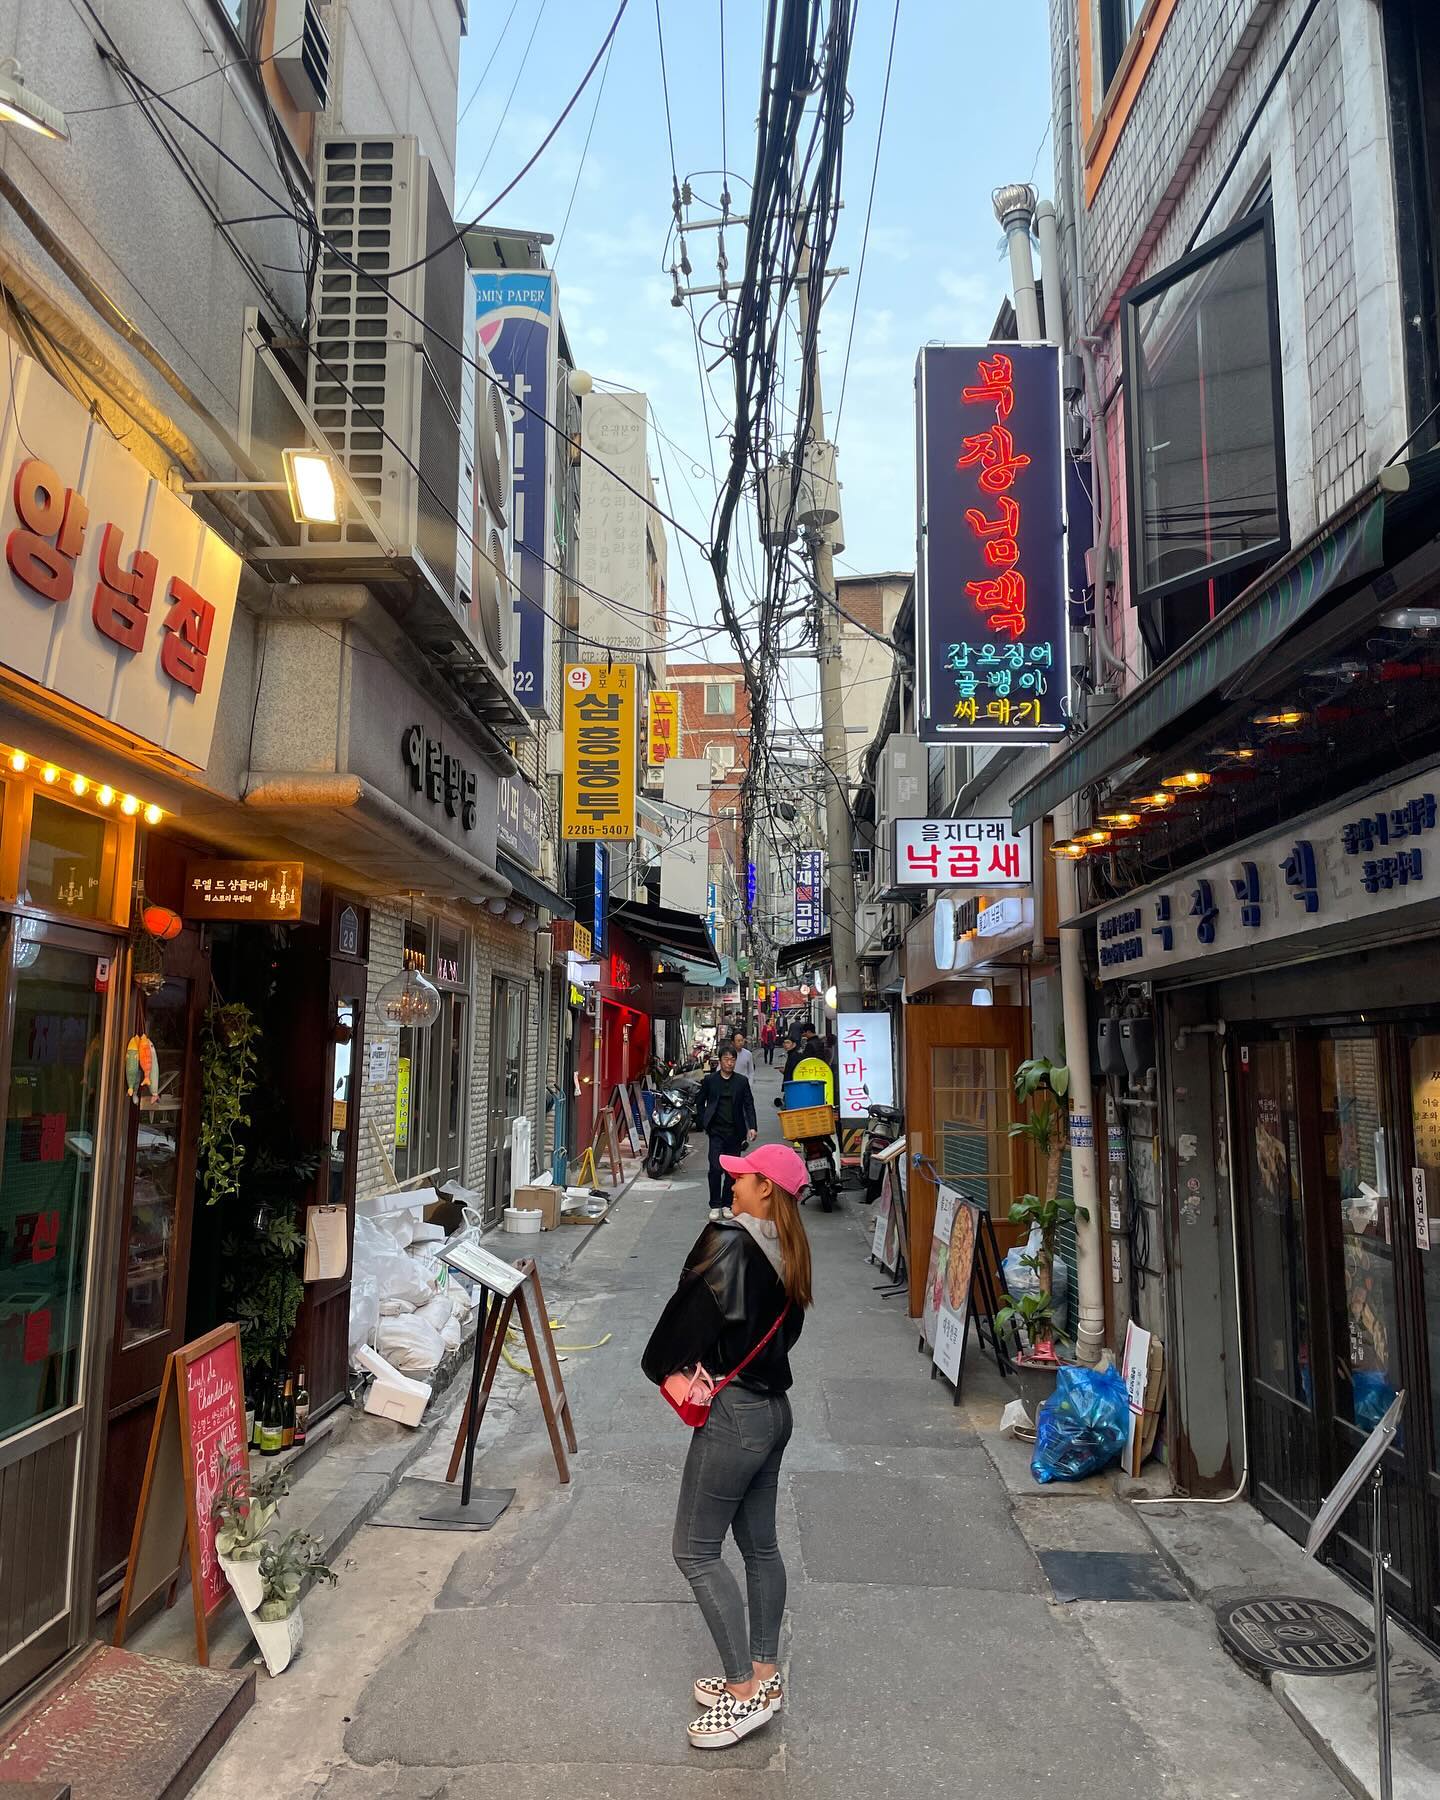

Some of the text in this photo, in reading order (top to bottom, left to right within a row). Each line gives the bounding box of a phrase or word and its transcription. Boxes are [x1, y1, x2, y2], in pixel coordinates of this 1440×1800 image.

[507, 289, 545, 302] PAPER
[6, 457, 217, 695] 양념집
[581, 651, 595, 662] CTP
[945, 641, 1052, 669] 갑오징어
[572, 672, 587, 688] 약
[954, 669, 1042, 698] 골뱅이
[953, 697, 1041, 726] 싸대기
[653, 695, 673, 763] 노래방
[573, 693, 623, 821] 삼흥봉투
[567, 824, 629, 835] 2285-5407
[921, 823, 1005, 842] 을지다래
[907, 844, 1020, 878] 낙곱새
[191, 878, 268, 892] 루엘 드 샹들리에
[343, 930, 354, 949] 28
[799, 1066, 829, 1078] 주마등
[842, 1027, 869, 1113] 주마등
[1414, 1174, 1426, 1236] 영업중
[220, 1420, 238, 1446] WINE
